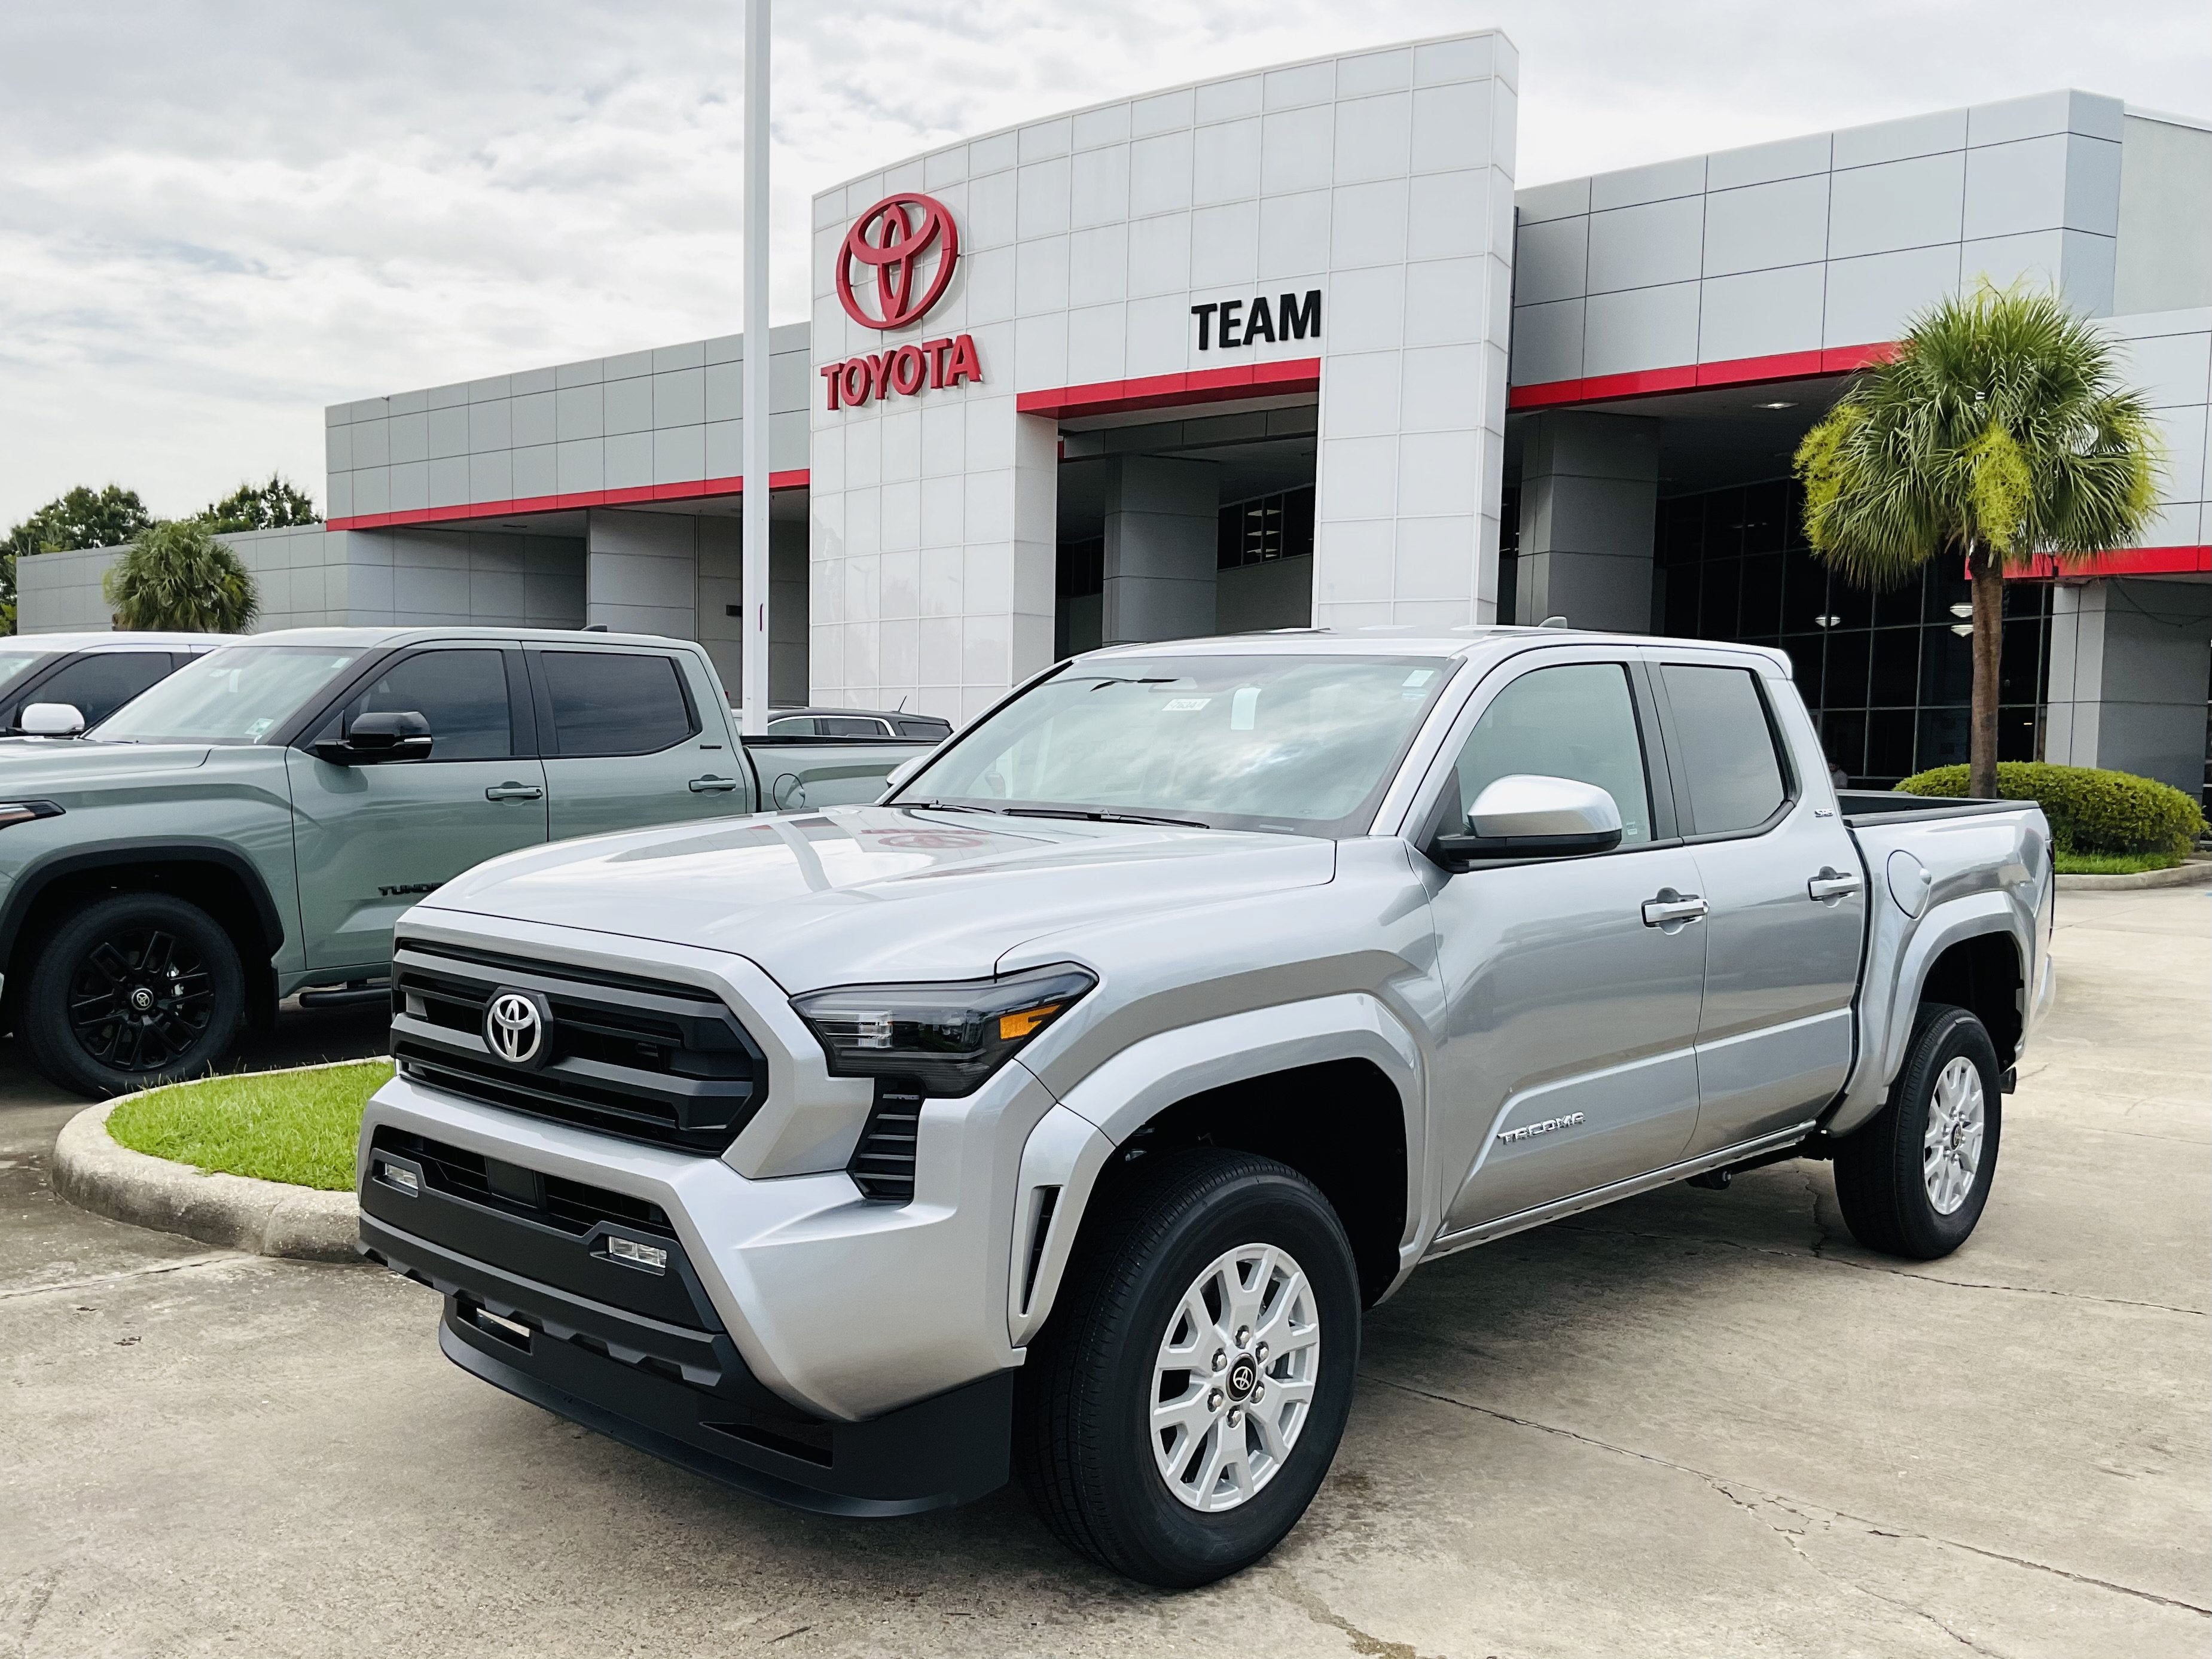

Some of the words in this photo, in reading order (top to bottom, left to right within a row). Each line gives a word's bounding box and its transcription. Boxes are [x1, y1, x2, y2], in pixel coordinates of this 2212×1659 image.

[1191, 289, 1320, 350] TEAM
[820, 334, 982, 410] TOYOTA
[1497, 1112, 1585, 1145] TACOMA
